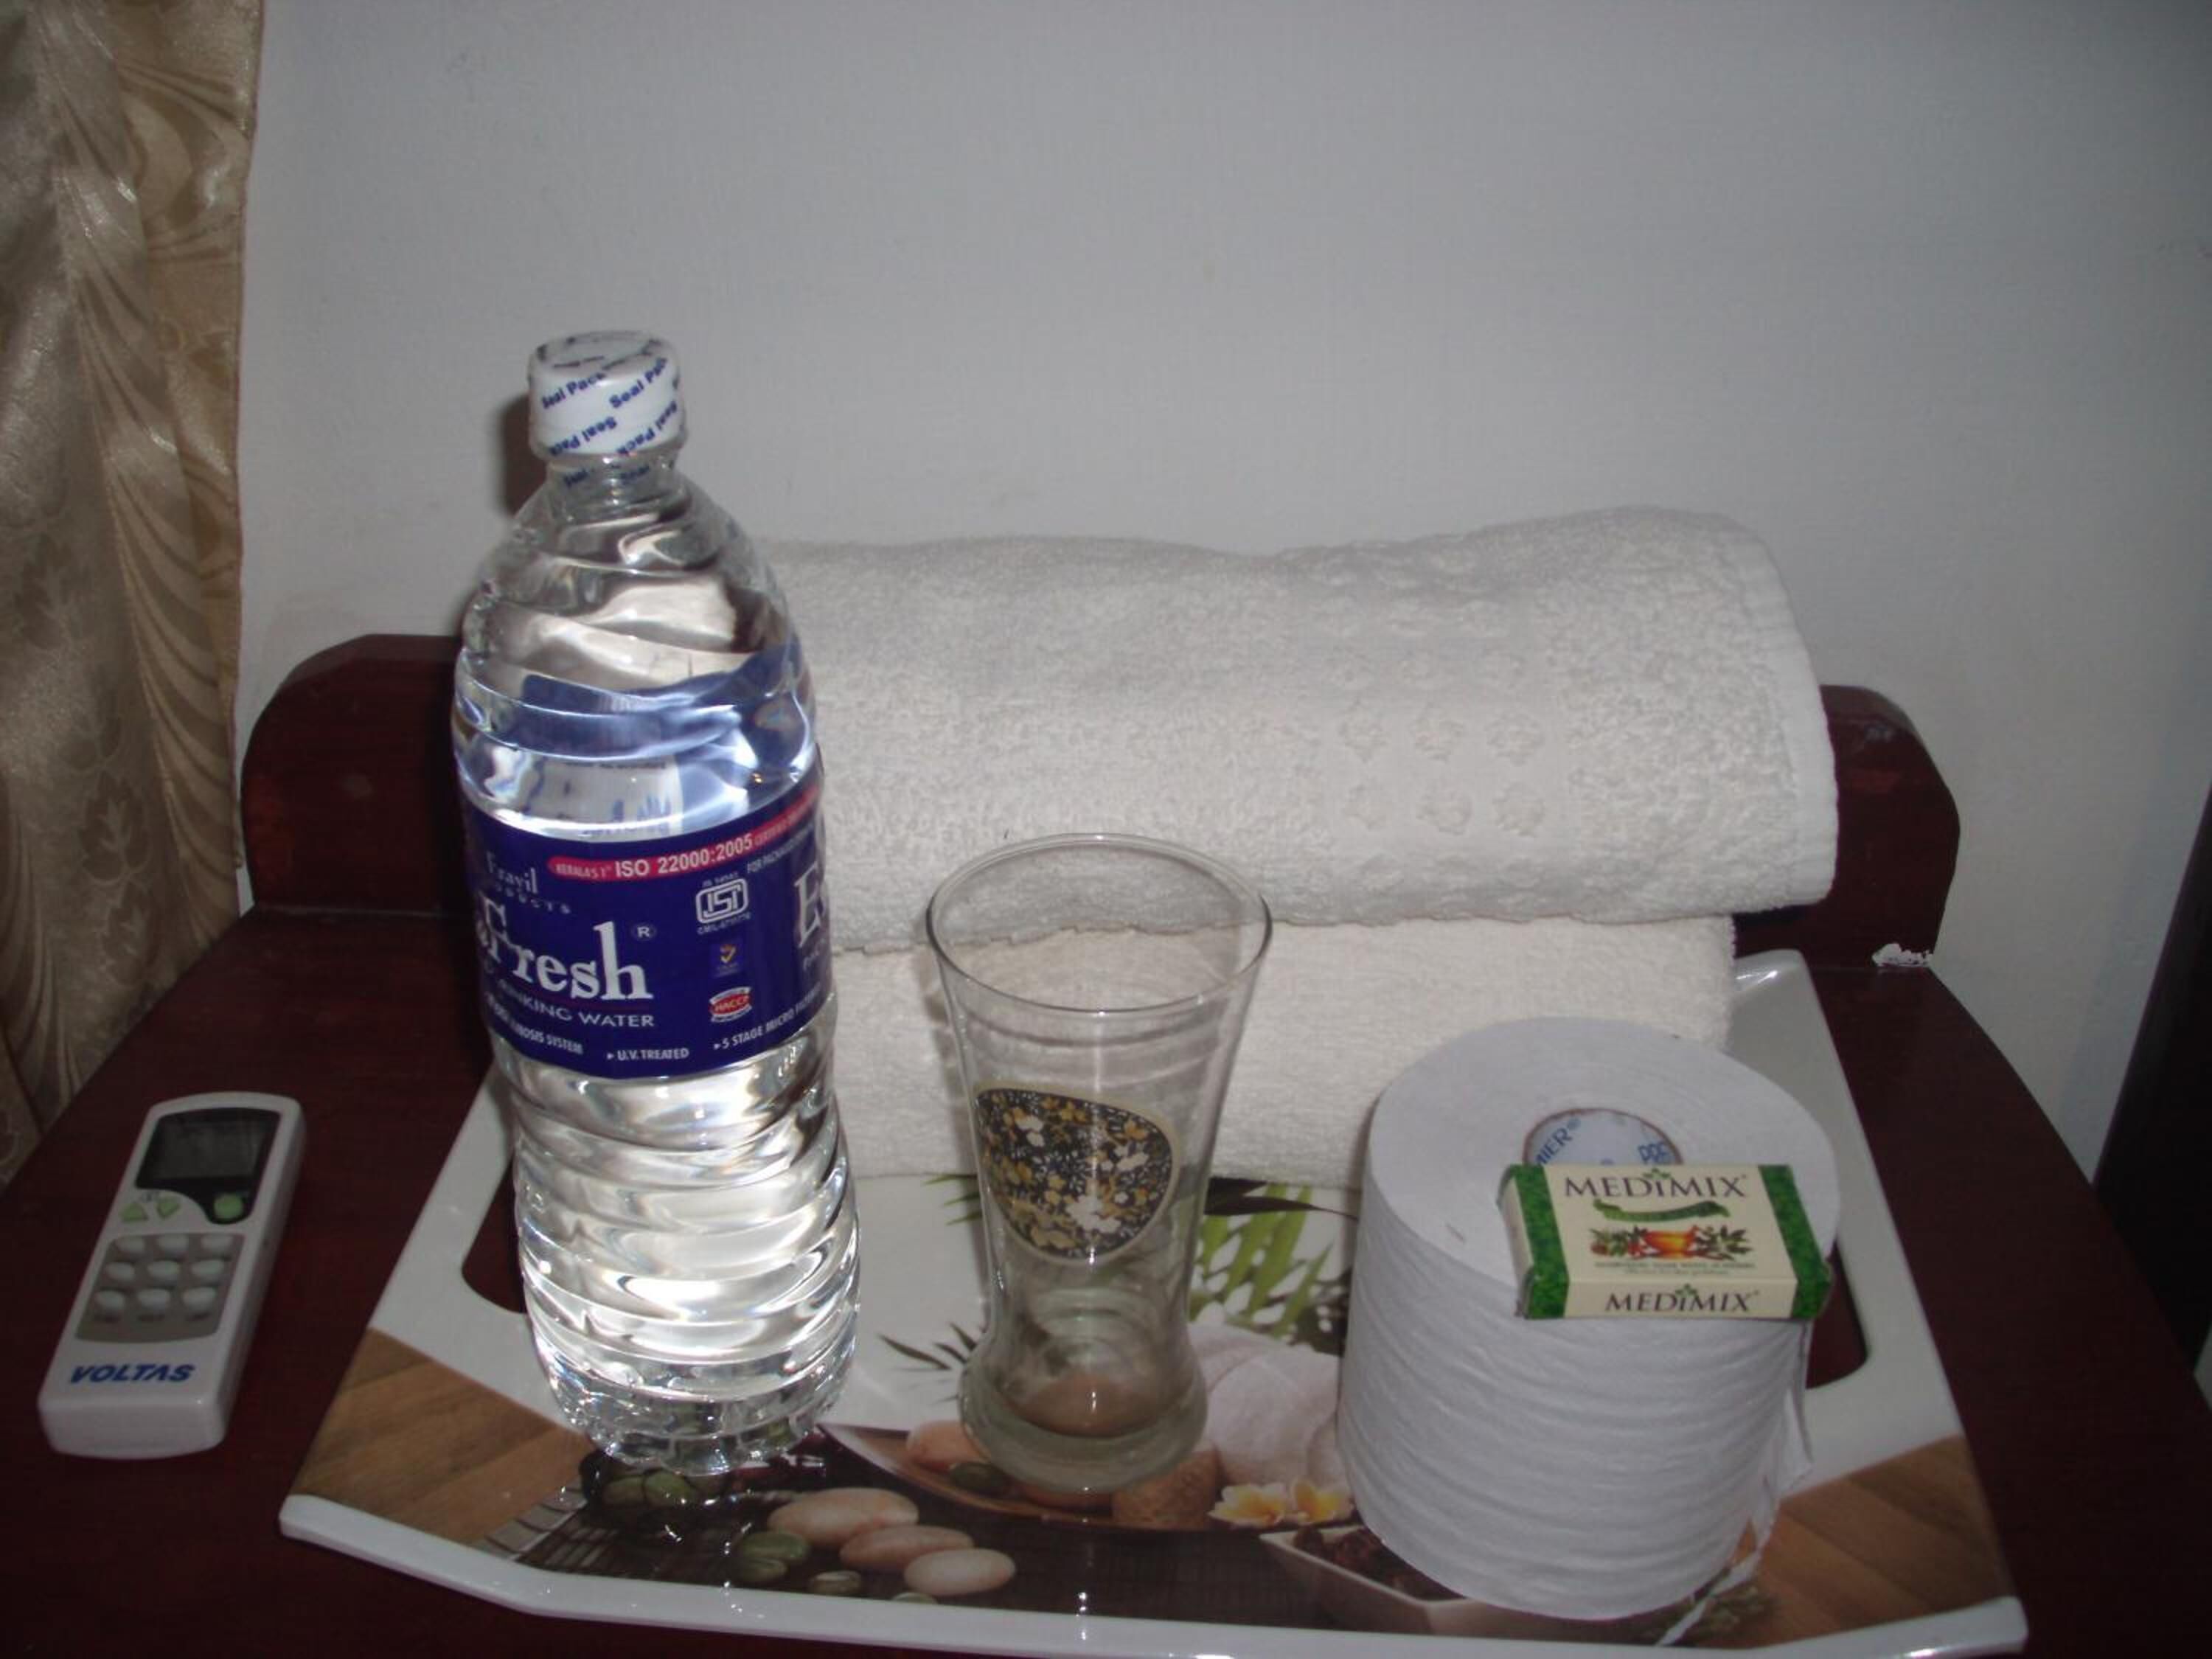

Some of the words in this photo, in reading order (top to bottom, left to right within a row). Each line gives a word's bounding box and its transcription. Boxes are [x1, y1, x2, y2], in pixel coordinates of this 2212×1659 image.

[609, 379, 644, 408] Seal
[581, 416, 617, 443] Seal
[614, 859, 650, 878] ISO
[657, 832, 753, 874] 22000:2005
[578, 1012, 655, 1028] WATER
[721, 1037, 730, 1050] 5
[731, 1025, 764, 1047] STAGE
[69, 1363, 195, 1385] VOLTAS
